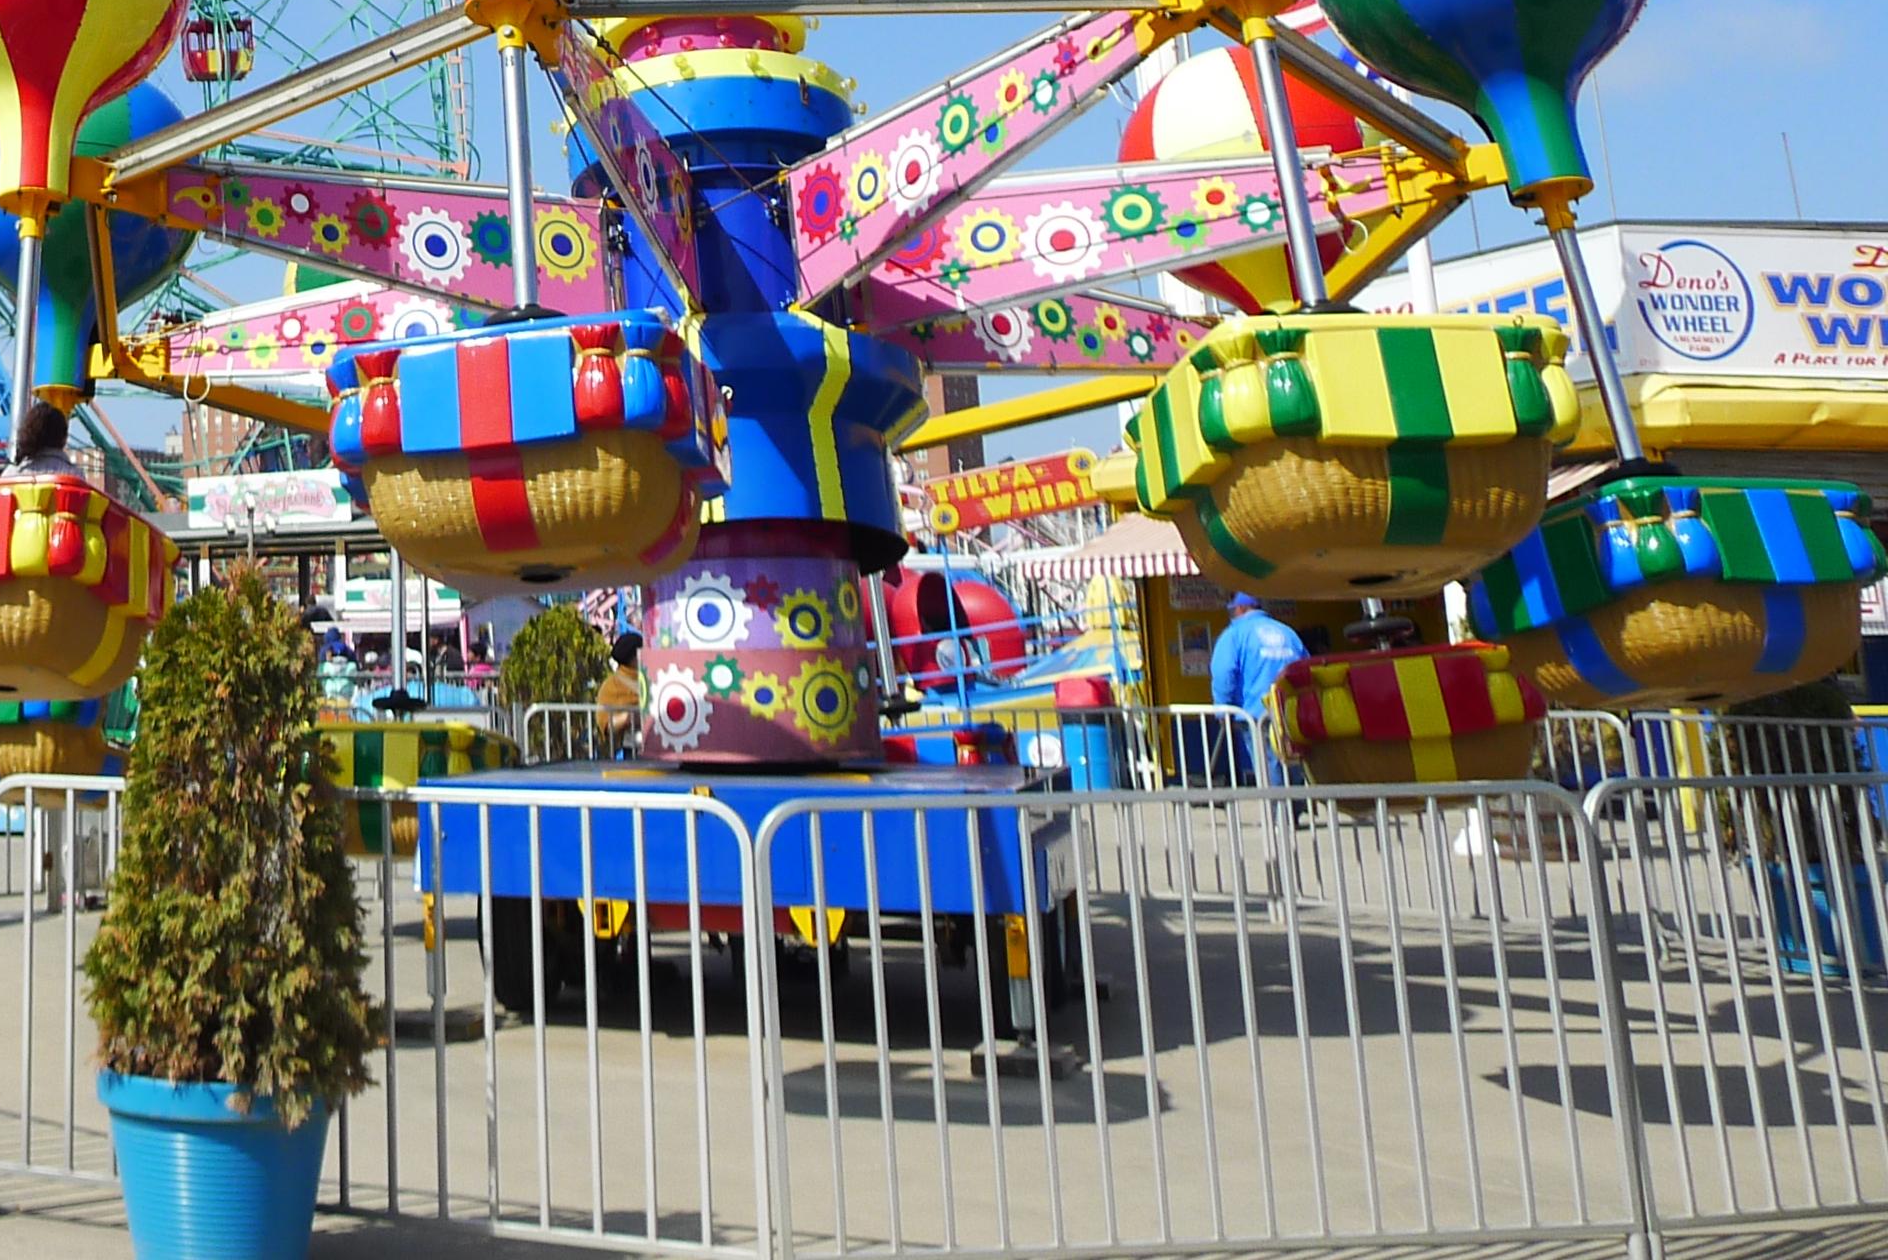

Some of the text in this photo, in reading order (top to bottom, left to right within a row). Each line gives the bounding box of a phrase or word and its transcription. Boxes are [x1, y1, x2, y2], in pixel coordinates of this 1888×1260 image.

[1638, 252, 1730, 290] Deno's
[1649, 292, 1740, 312] WONDER
[1760, 272, 1888, 312] WO
[1662, 314, 1733, 333] WHEEL
[1774, 352, 1786, 365] A
[981, 477, 1098, 521] WHIRL
